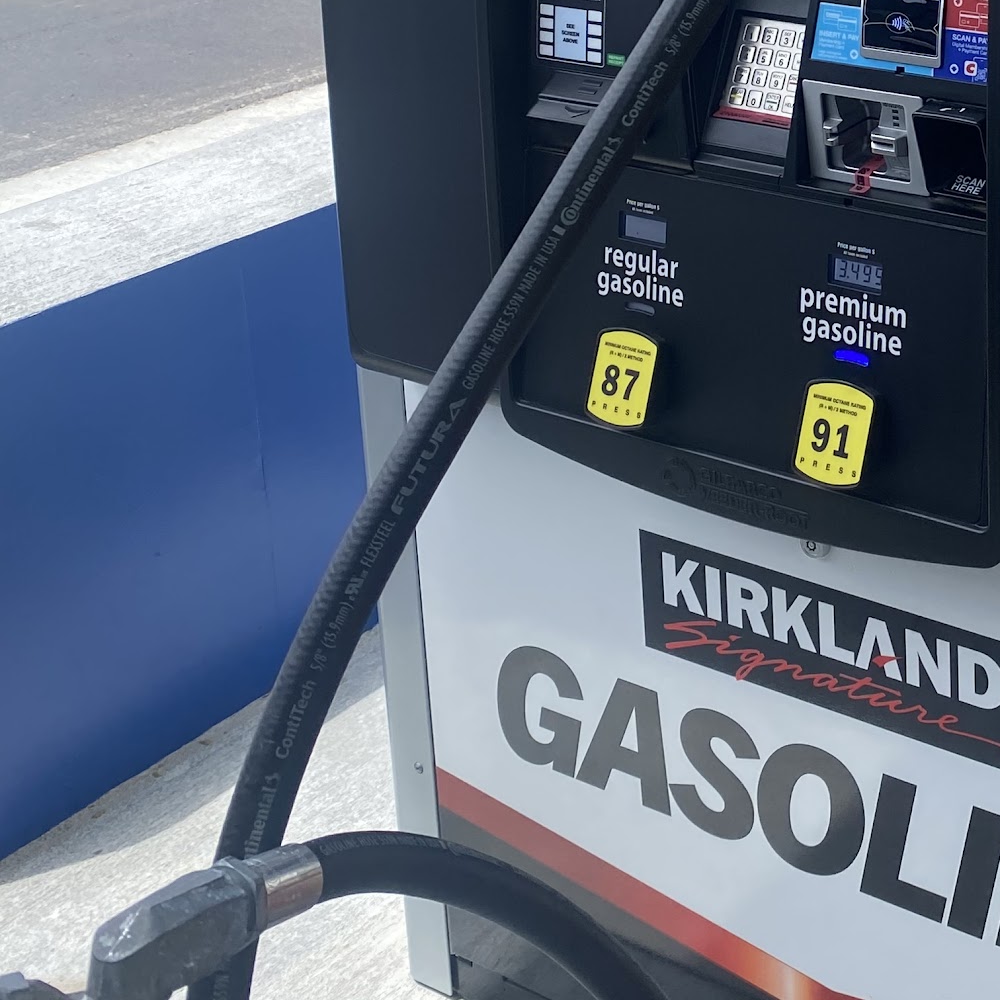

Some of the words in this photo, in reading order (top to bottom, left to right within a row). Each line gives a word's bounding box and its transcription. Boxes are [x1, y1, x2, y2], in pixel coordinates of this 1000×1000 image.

[561, 29, 580, 38] SCREEN
[562, 37, 579, 45] ABOVE
[621, 59, 670, 128] ContiTech
[560, 144, 616, 227] Continental
[951, 183, 982, 196] HERE
[955, 174, 986, 188] SCAN
[604, 246, 679, 279] regular
[597, 271, 684, 307] gasoline
[800, 286, 907, 328] premium
[802, 316, 902, 356] gasoline
[601, 364, 640, 401] 87
[591, 400, 641, 419] PRESS
[391, 397, 468, 515] FUTURA
[811, 418, 850, 459] 91
[799, 457, 857, 478] PRESS
[359, 519, 397, 576] FLEXSTEEL
[275, 679, 316, 760] ContiTech
